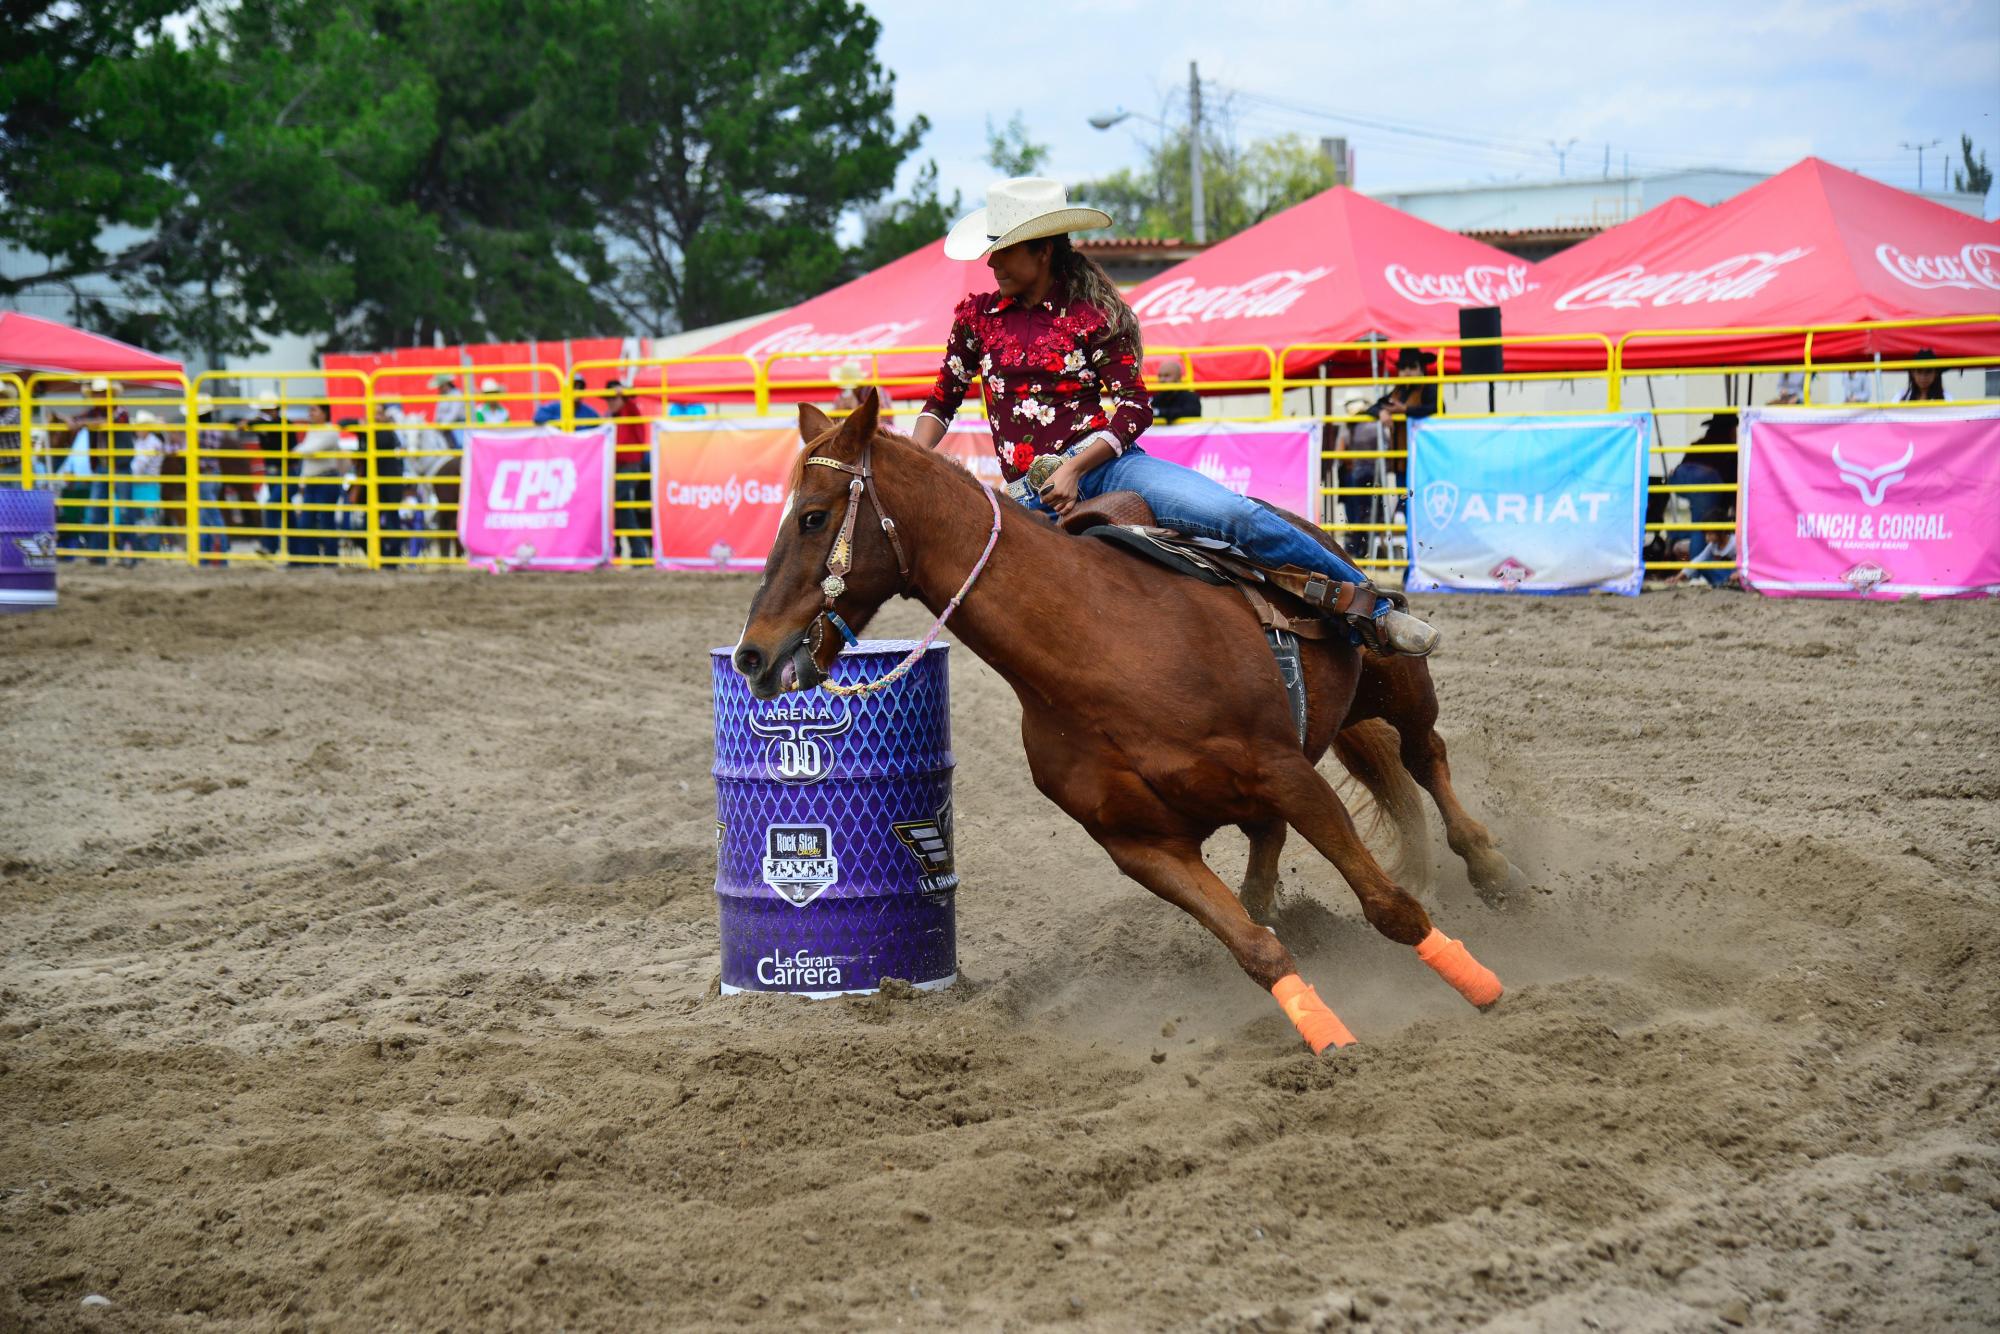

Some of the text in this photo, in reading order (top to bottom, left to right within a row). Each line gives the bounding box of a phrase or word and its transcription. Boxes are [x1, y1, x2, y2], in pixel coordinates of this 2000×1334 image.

[488, 458, 576, 510] CPS
[667, 480, 783, 509] Cargo Gas
[1460, 493, 1610, 523] ARIAT
[1797, 513, 1855, 538] RANCH
[1858, 515, 1875, 539] &
[765, 708, 830, 720] ARENA
[776, 833, 797, 853] Rock
[798, 833, 818, 851] Star
[757, 957, 841, 985] Carrera
[775, 948, 833, 967] La Gran
